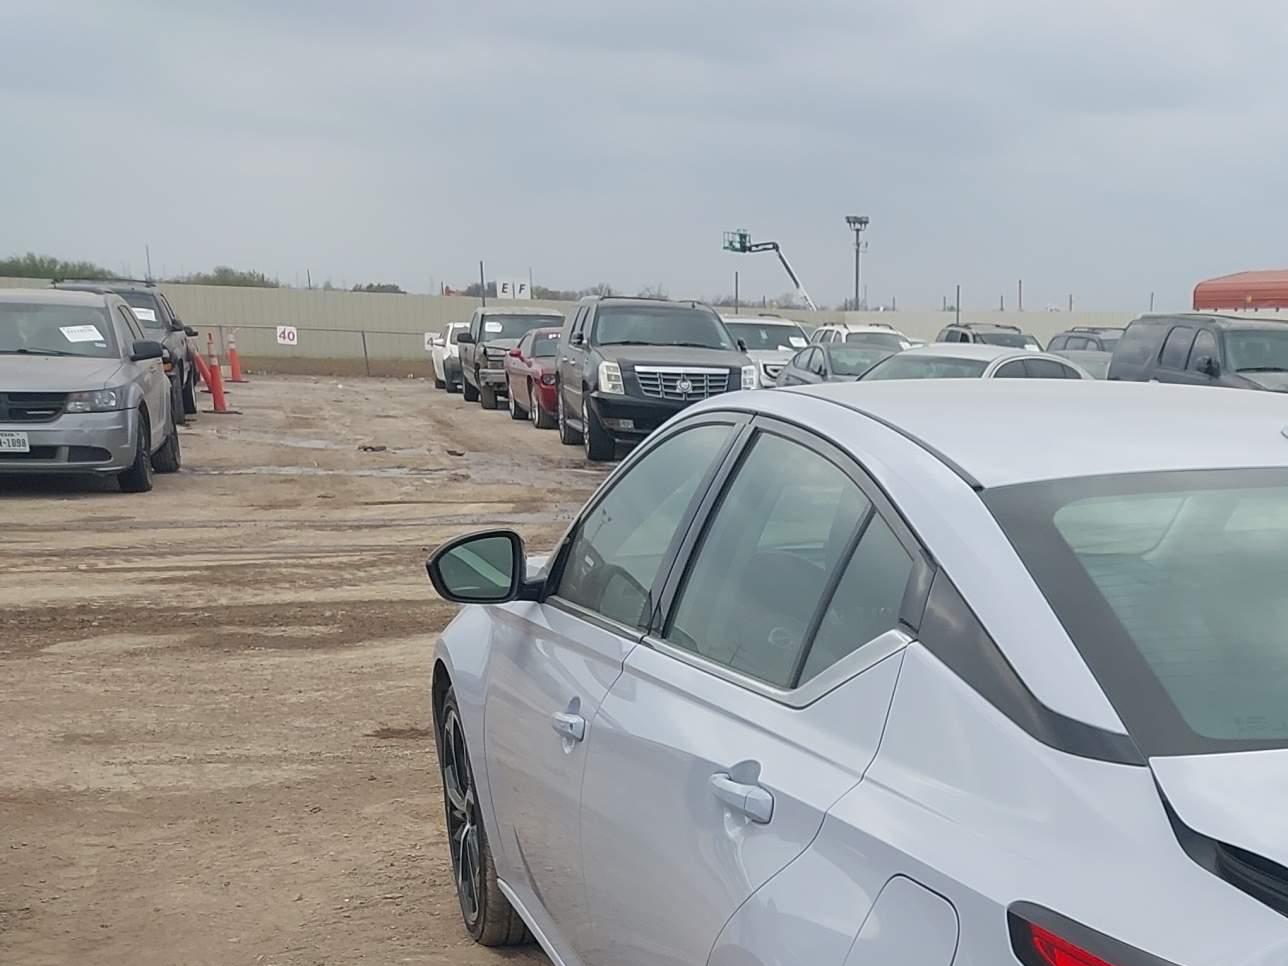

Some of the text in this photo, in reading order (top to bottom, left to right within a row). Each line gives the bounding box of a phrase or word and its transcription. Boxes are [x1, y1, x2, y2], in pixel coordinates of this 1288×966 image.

[501, 282, 509, 294] E
[518, 283, 527, 294] F
[279, 327, 296, 341] 40
